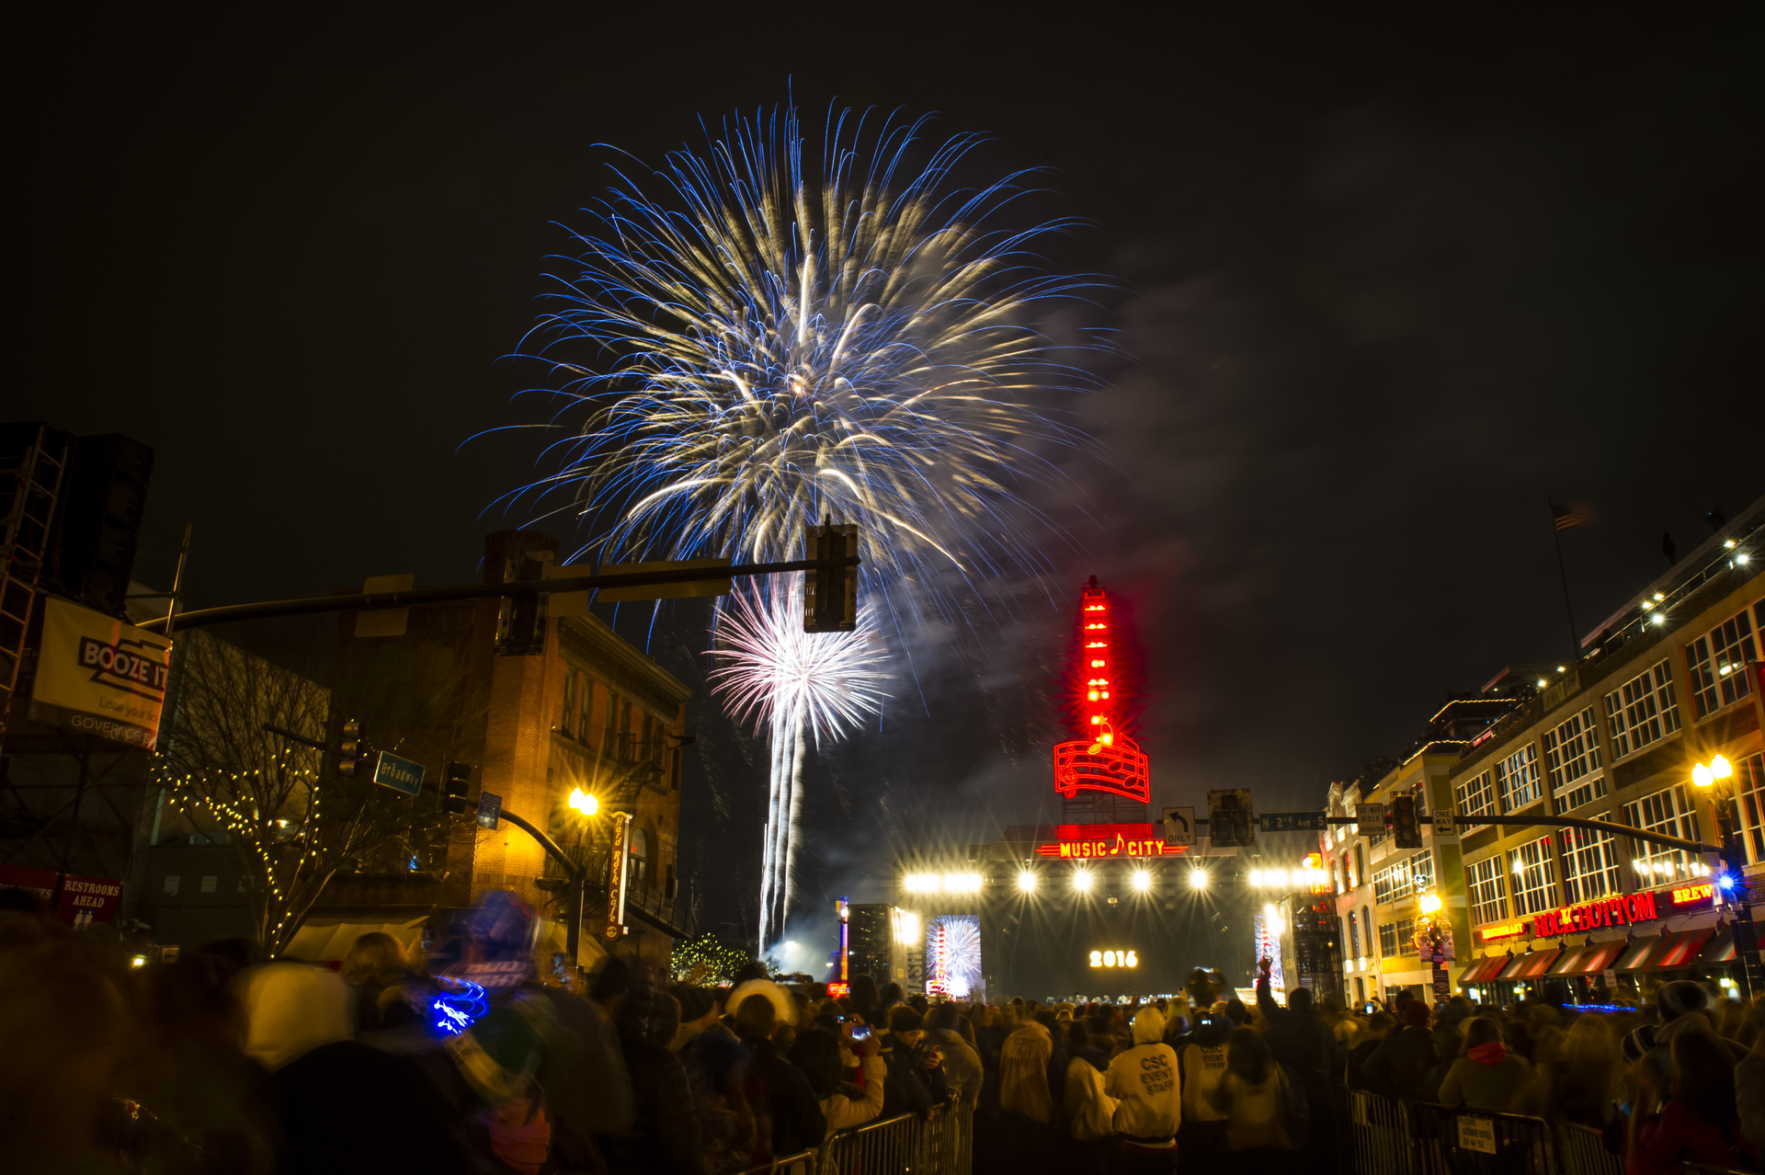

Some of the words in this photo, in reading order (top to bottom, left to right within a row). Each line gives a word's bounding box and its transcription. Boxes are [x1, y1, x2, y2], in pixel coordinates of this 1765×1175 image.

[83, 641, 151, 682] BOOZE
[99, 696, 124, 713] Lose
[125, 706, 146, 719] your
[380, 761, 420, 788] Broadway
[614, 817, 624, 846] Hard
[1168, 834, 1191, 843] ONLY
[1059, 841, 1107, 858] MUSIC
[1127, 840, 1165, 857] CITY
[611, 850, 621, 885] Rock
[64, 880, 120, 897] RESTROOMS
[72, 895, 105, 908] AHEAD
[609, 889, 619, 922] Cafe
[1534, 907, 1577, 938] ROCK
[1576, 890, 1658, 931] BOTTOM
[1089, 950, 1139, 968] 2016
[1141, 1054, 1167, 1071] CSC
[1203, 1054, 1224, 1063] EVENT
[1204, 1062, 1225, 1070] STAFF
[1140, 1067, 1173, 1085] EVENT
